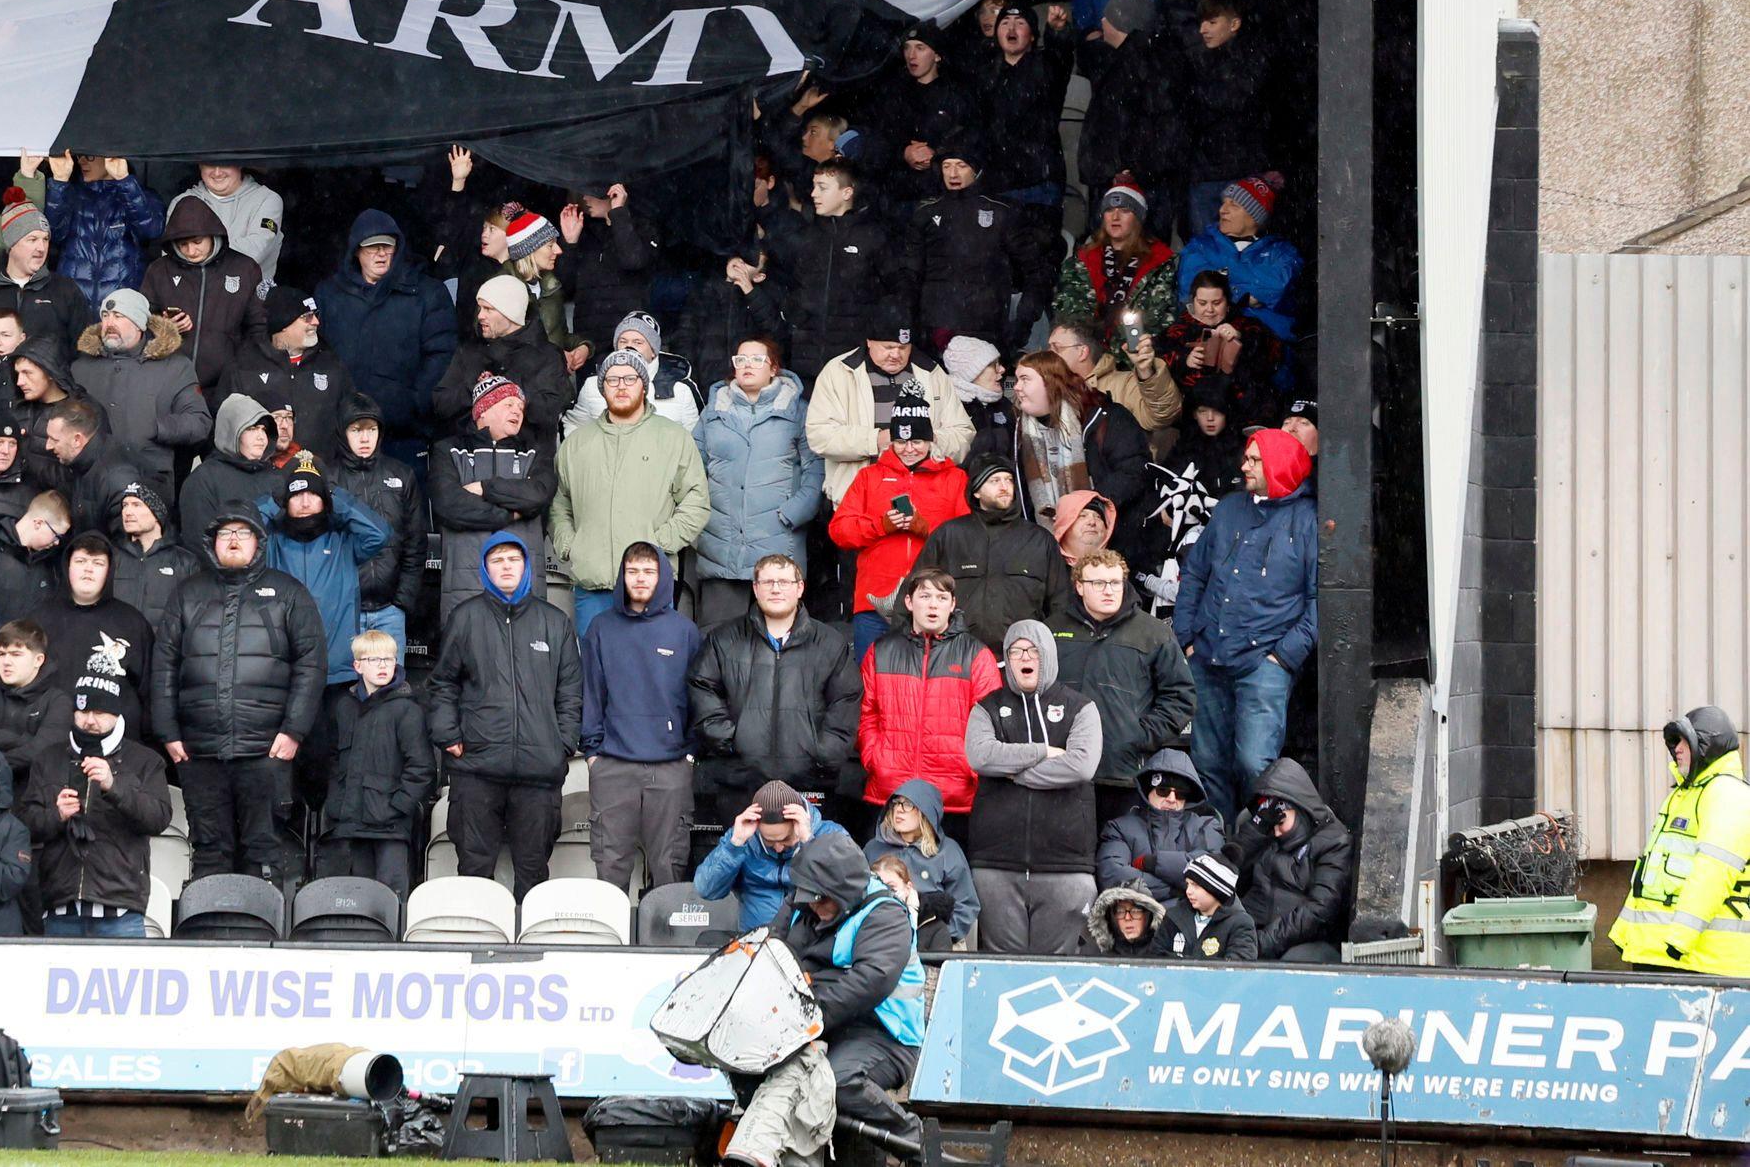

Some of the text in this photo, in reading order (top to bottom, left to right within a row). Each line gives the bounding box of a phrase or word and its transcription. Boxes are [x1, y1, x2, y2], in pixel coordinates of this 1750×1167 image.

[674, 914, 708, 923] SERVED
[45, 967, 615, 1022] DAVID WISE MOTORS LTD
[1153, 1000, 1625, 1073] MARNER
[29, 1052, 162, 1082] SALES
[1148, 1065, 1184, 1085] WE
[1192, 1066, 1261, 1087] ONLY
[1268, 1070, 1330, 1090] SING
[1511, 1079, 1619, 1104] FISHING
